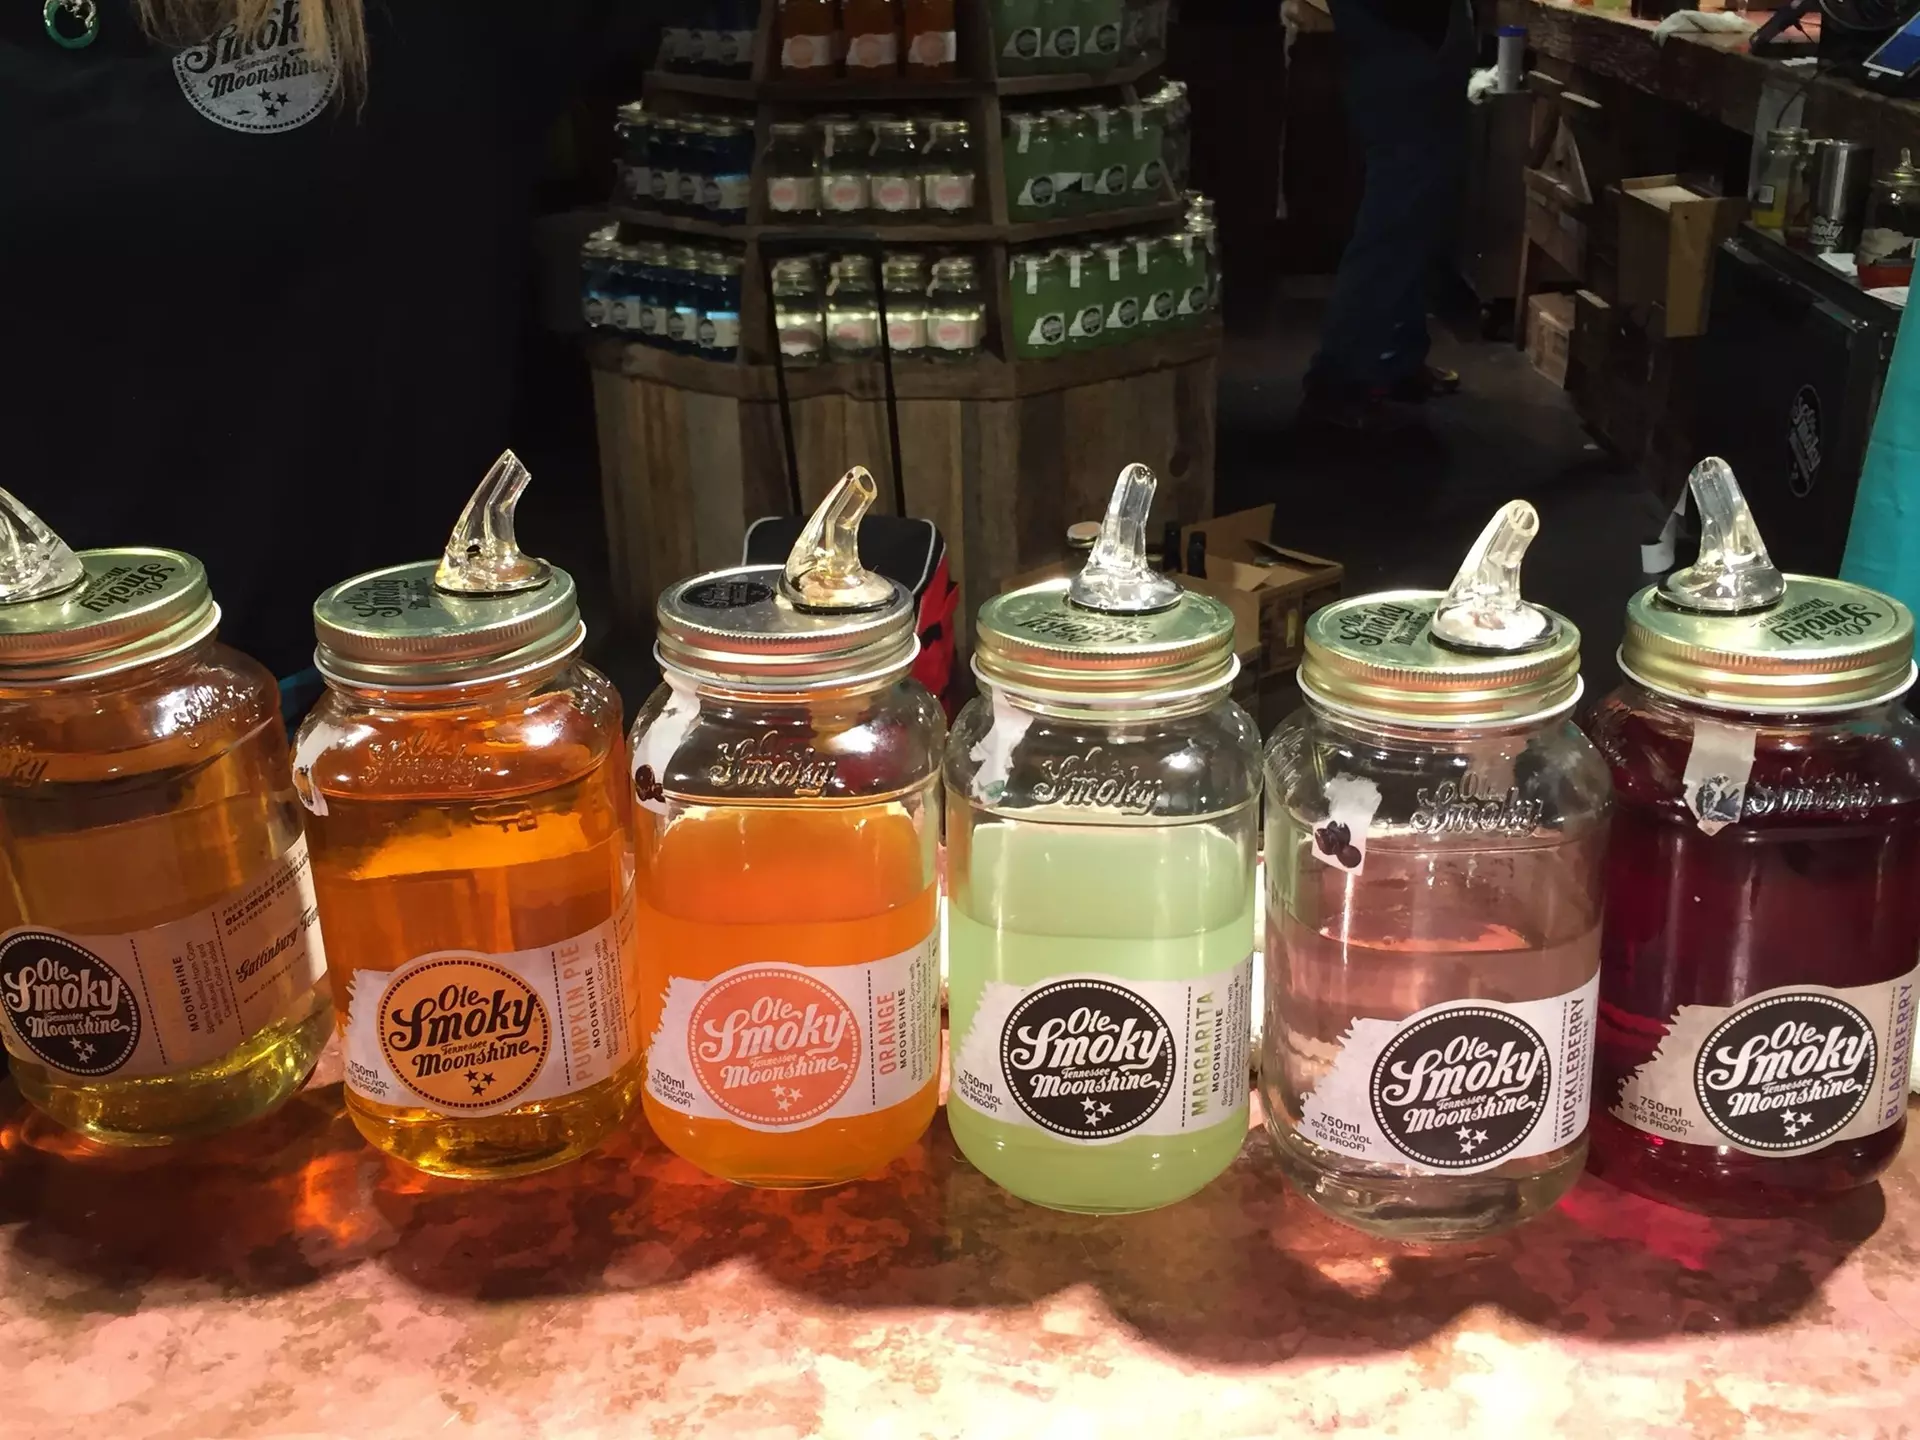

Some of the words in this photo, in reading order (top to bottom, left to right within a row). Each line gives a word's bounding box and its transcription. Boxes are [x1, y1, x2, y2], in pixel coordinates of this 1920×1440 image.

[185, 0, 305, 73] Smok
[79, 563, 176, 613] Smoky
[1340, 603, 1414, 646] Smoky
[1770, 603, 1882, 645] Smoky
[1820, 622, 1864, 637] Ole
[36, 958, 80, 982] Ole
[560, 943, 581, 980] PIE
[3, 965, 122, 1017] Smoky
[172, 956, 200, 1032] MOONSHINE
[438, 984, 490, 1012] Ole
[584, 967, 601, 1048] MOONSHINE
[25, 1014, 130, 1039] Moonshine
[388, 989, 538, 1052] Smoky
[751, 996, 803, 1024] Ole
[897, 988, 907, 1069] MOONSHINE
[1067, 1007, 1120, 1035] Ole
[440, 1040, 488, 1056] Tennessee
[566, 982, 595, 1082] PUMPKIN
[698, 1003, 850, 1063] Smoky
[876, 990, 897, 1076] ORANGE
[1010, 1018, 1167, 1072] Smoky
[1211, 1008, 1224, 1092] MOONSHINE
[1444, 1035, 1497, 1065] Ole
[1770, 1020, 1825, 1050] Ole
[350, 1060, 378, 1079] 750ml
[411, 1039, 540, 1078] Moonshine
[750, 1053, 797, 1068] Tennessee
[1190, 991, 1216, 1118] MARGARITA
[1560, 997, 1585, 1140] HUCKLEBERRY
[1577, 1019, 1590, 1104] MOONSHINE
[1706, 1025, 1874, 1091] Smoky
[1884, 983, 1913, 1120] BLACKBERRY
[656, 1068, 685, 1089] 750ml
[719, 1054, 848, 1090] Moonshine
[963, 1069, 993, 1094] 750ml
[1030, 1070, 1161, 1098] Moonshine
[1061, 1066, 1110, 1079] Tennessee
[1382, 1041, 1545, 1106] Smoky
[1762, 1079, 1813, 1095] Tennessee
[1403, 1093, 1537, 1134] Moonshine
[1436, 1094, 1487, 1111] Tennessee
[1640, 1095, 1682, 1117] 750ml
[1727, 1078, 1863, 1118] Moonshine
[1311, 1118, 1327, 1132] 20%
[1320, 1112, 1360, 1134] 750ml
[1634, 1112, 1648, 1123] (40
[1650, 1119, 1687, 1136] PROOF)
[1329, 1136, 1366, 1152] PROOF)
